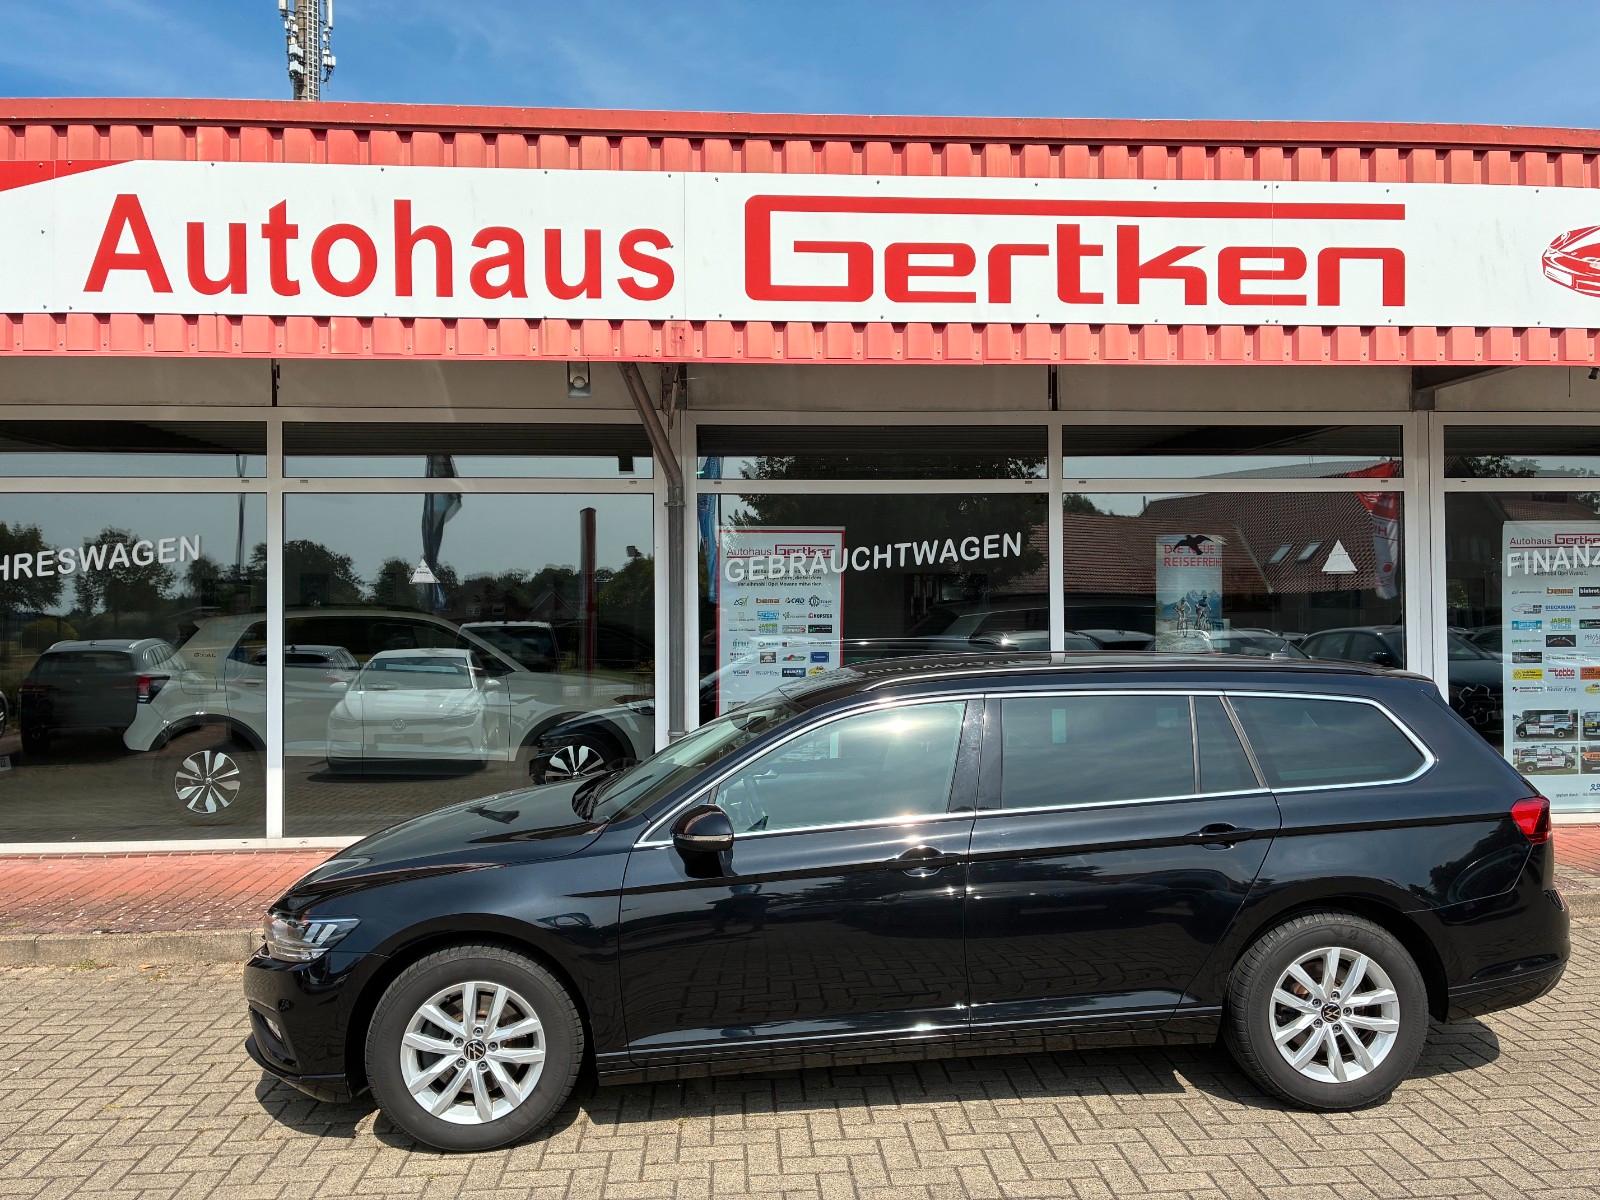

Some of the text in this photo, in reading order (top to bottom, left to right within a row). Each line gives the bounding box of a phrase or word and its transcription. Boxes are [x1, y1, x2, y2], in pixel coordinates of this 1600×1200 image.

[86, 194, 1405, 306] Autohaus Gertken
[726, 546, 772, 556] Autohaus
[1510, 536, 1552, 546] Autohaus
[724, 531, 1022, 583] GEBRAUCHTWAGEN
